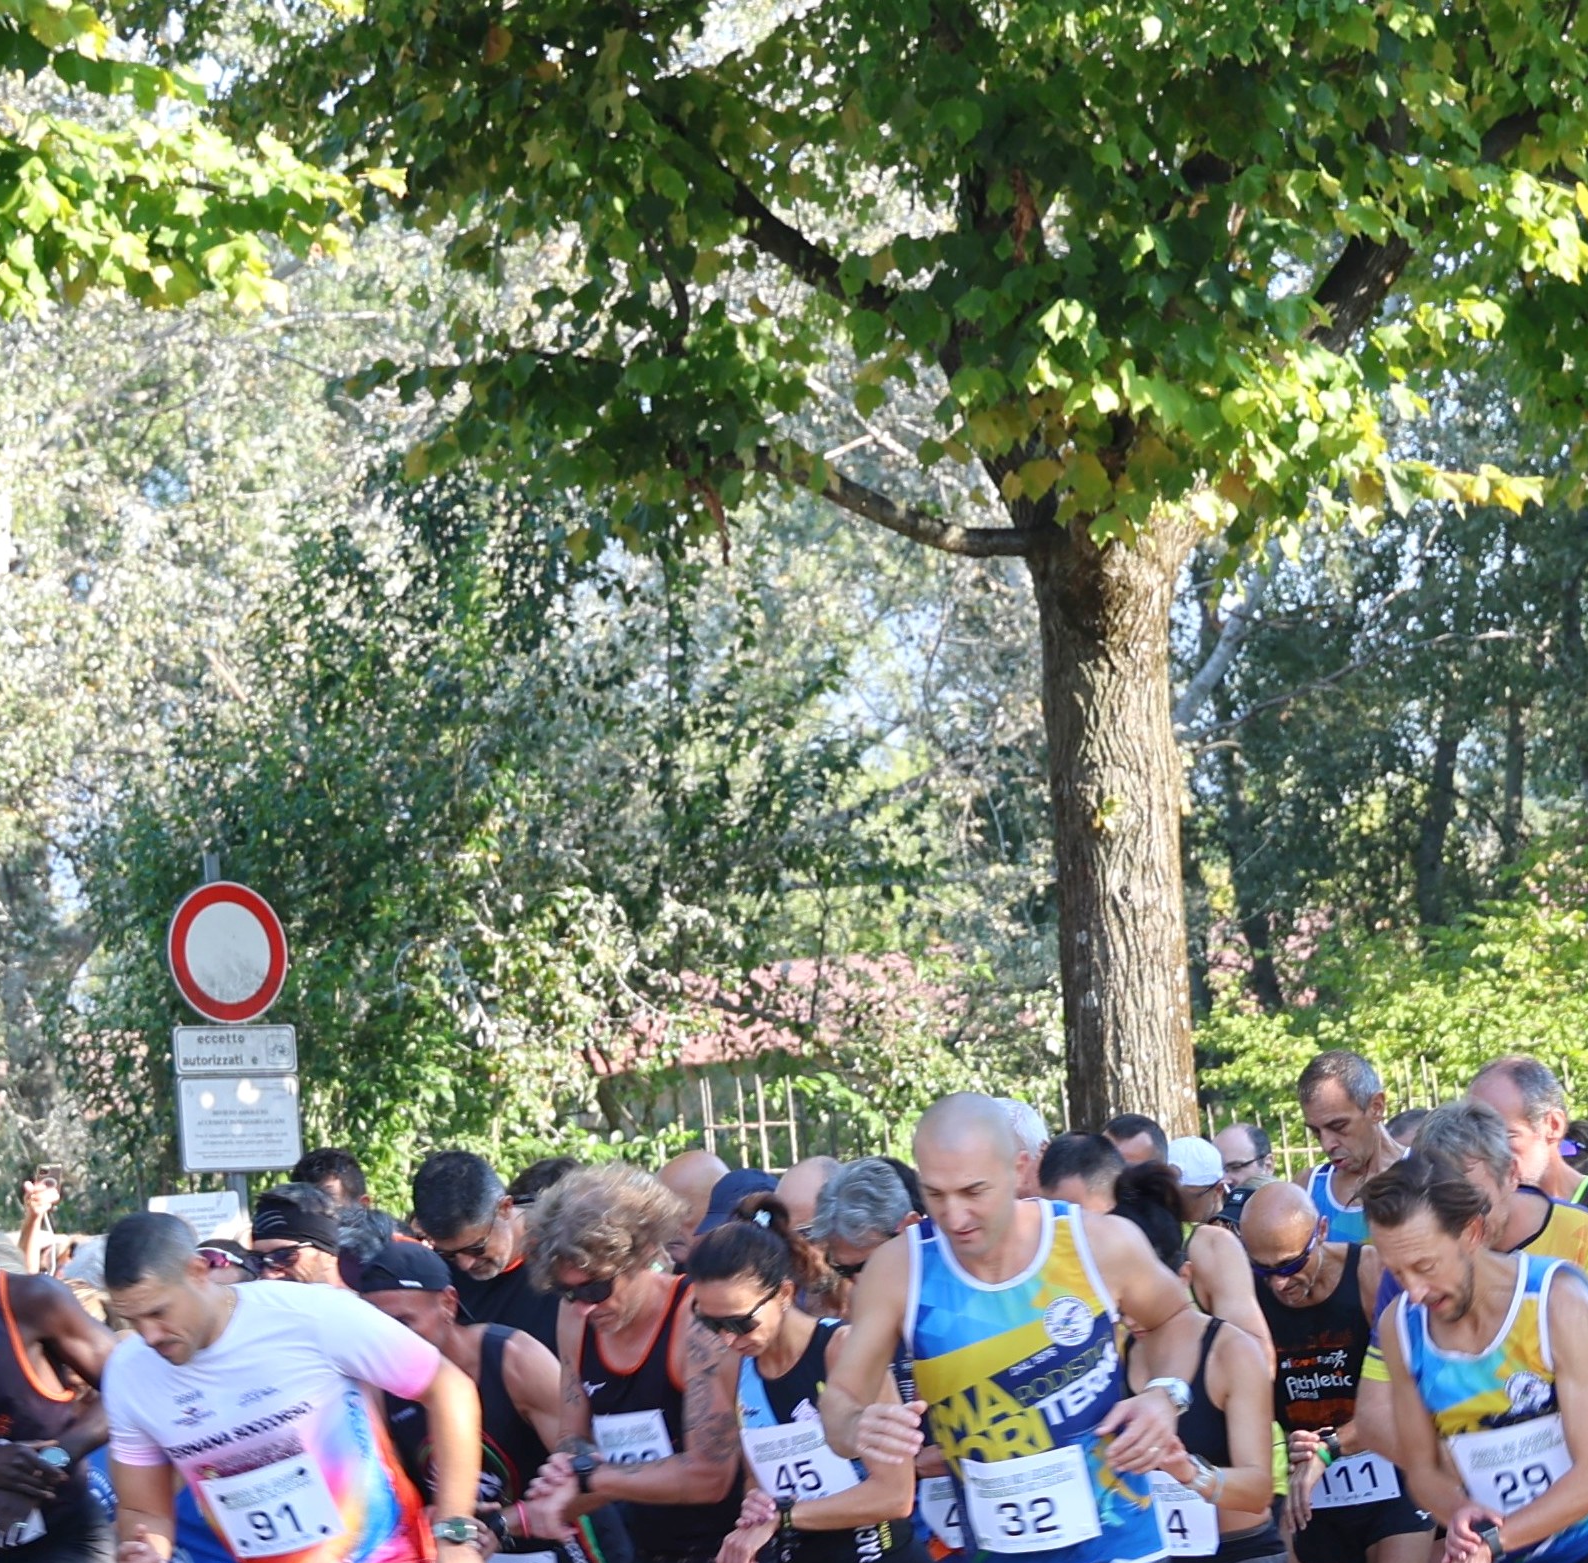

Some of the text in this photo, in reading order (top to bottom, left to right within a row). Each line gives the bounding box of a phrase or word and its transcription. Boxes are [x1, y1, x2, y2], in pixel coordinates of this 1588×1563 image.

[197, 1033, 245, 1044] eccetto
[182, 1055, 258, 1066] autorizzati e
[1285, 1371, 1353, 1400] Athletic
[775, 1459, 824, 1495] 45
[1320, 1460, 1380, 1495] 111
[1493, 1463, 1552, 1507] 29
[246, 1502, 304, 1541] 91
[996, 1496, 1060, 1537] 32
